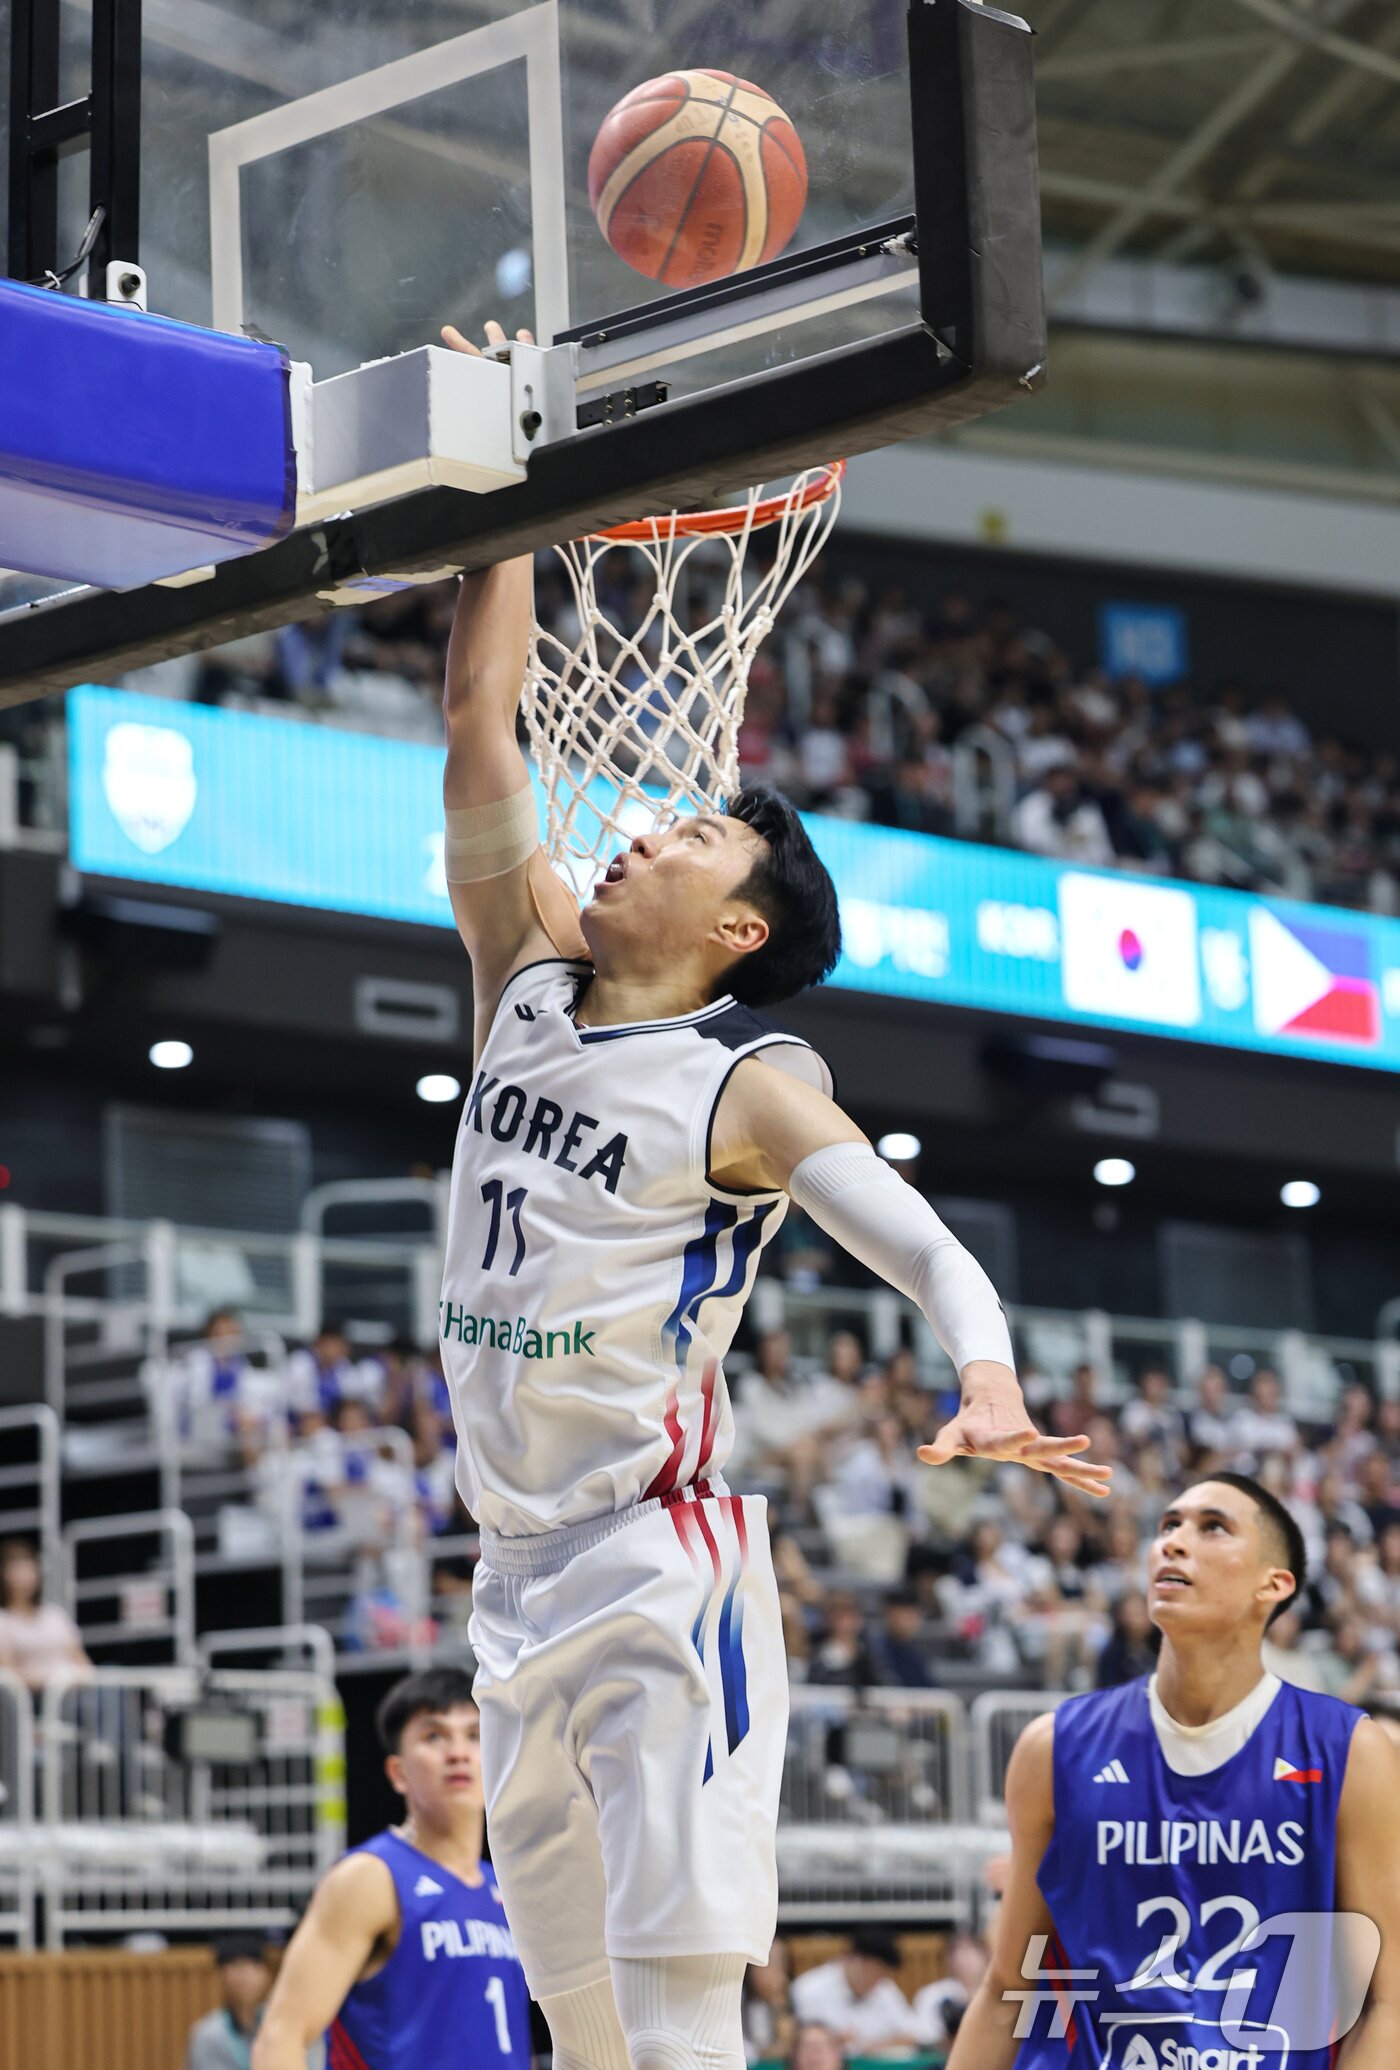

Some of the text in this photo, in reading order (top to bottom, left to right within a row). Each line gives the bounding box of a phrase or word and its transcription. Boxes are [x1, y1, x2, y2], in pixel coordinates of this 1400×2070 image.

[465, 1071, 629, 1195] KOREA
[481, 1179, 528, 1277] 11
[443, 1302, 597, 1359] HanaBank
[1097, 1819, 1305, 1866] PILIPINAS
[420, 1918, 521, 1962] PILIPIN
[1130, 1896, 1260, 1991] 22
[484, 1976, 513, 2055] 1
[1160, 2037, 1266, 2070] Smart
